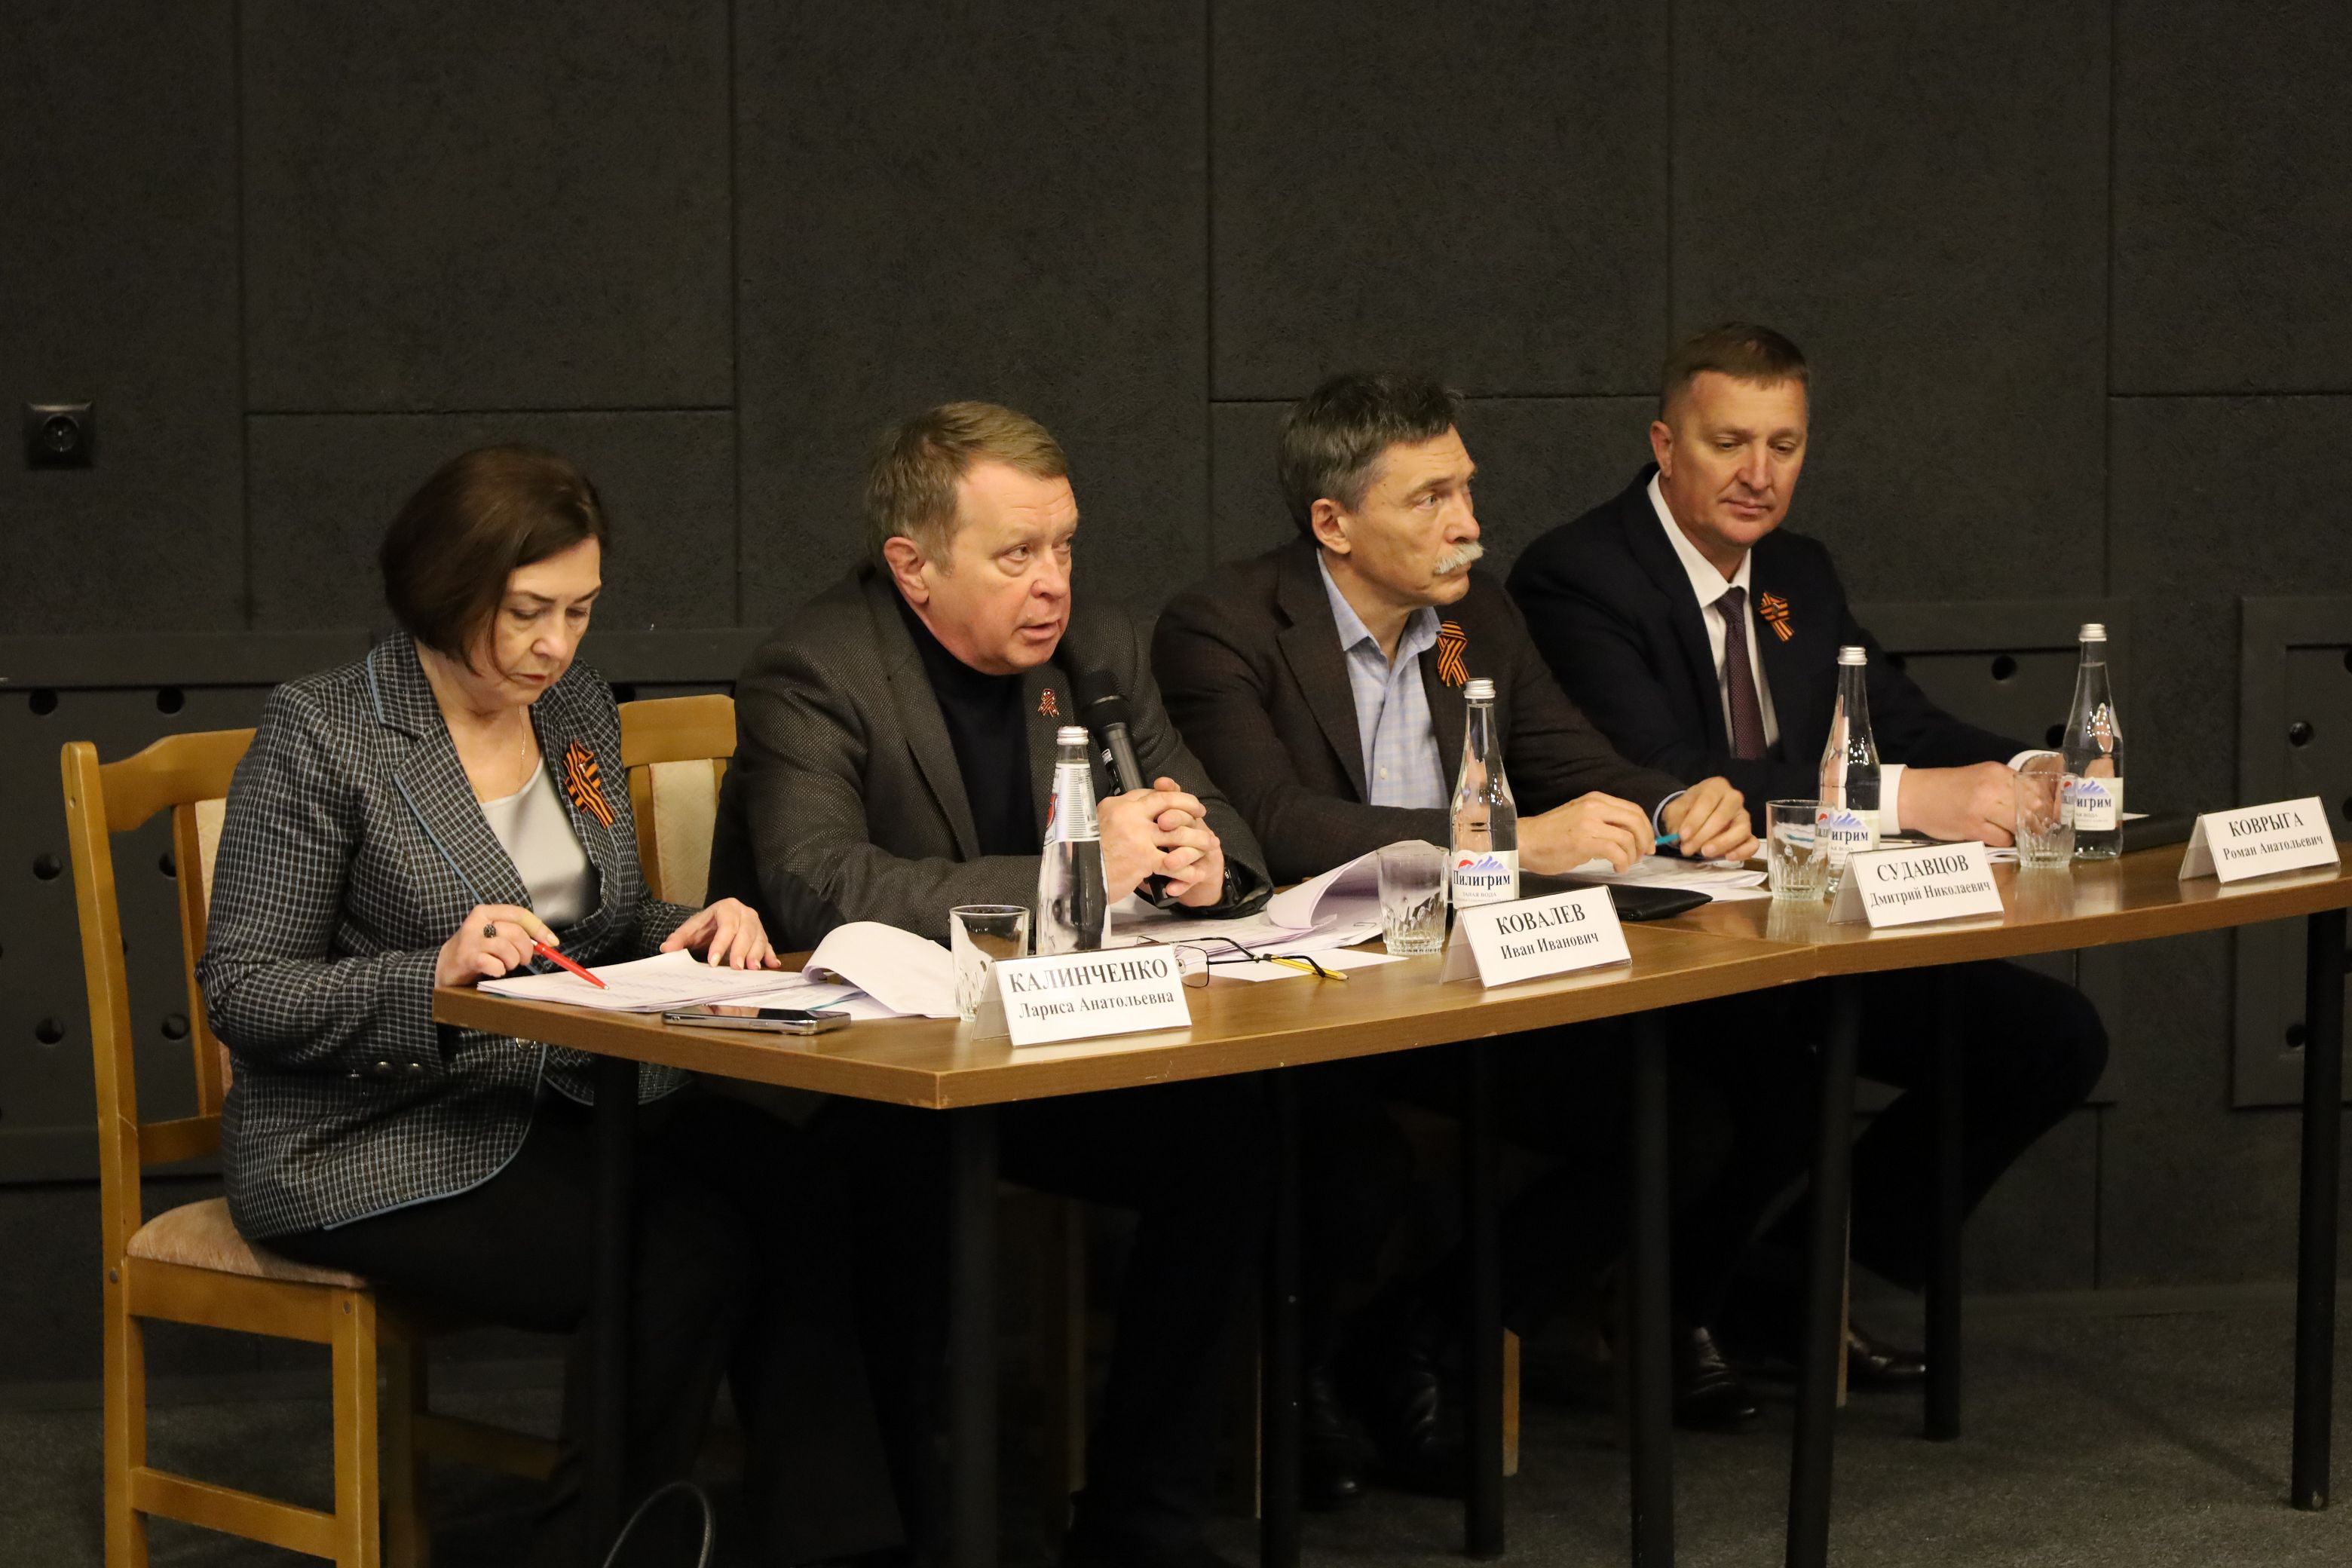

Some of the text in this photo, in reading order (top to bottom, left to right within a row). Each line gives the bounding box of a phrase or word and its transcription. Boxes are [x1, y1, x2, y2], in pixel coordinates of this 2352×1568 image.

[2228, 812, 2304, 838] КОВРЫГА
[2223, 835, 2323, 860] Роман Анатольевич
[1453, 870, 1510, 890] Пилигрим
[1876, 854, 1969, 882] СУДАВЦОВ
[1870, 880, 1991, 908] Дмитрий Николаевич
[1496, 903, 1585, 936] КОВАЛЕВ
[1500, 933, 1599, 960] Иван Иванович
[1008, 958, 1168, 993] КАЛИНЧЕНКО
[1018, 991, 1174, 1020] Лариса Анатольевна
